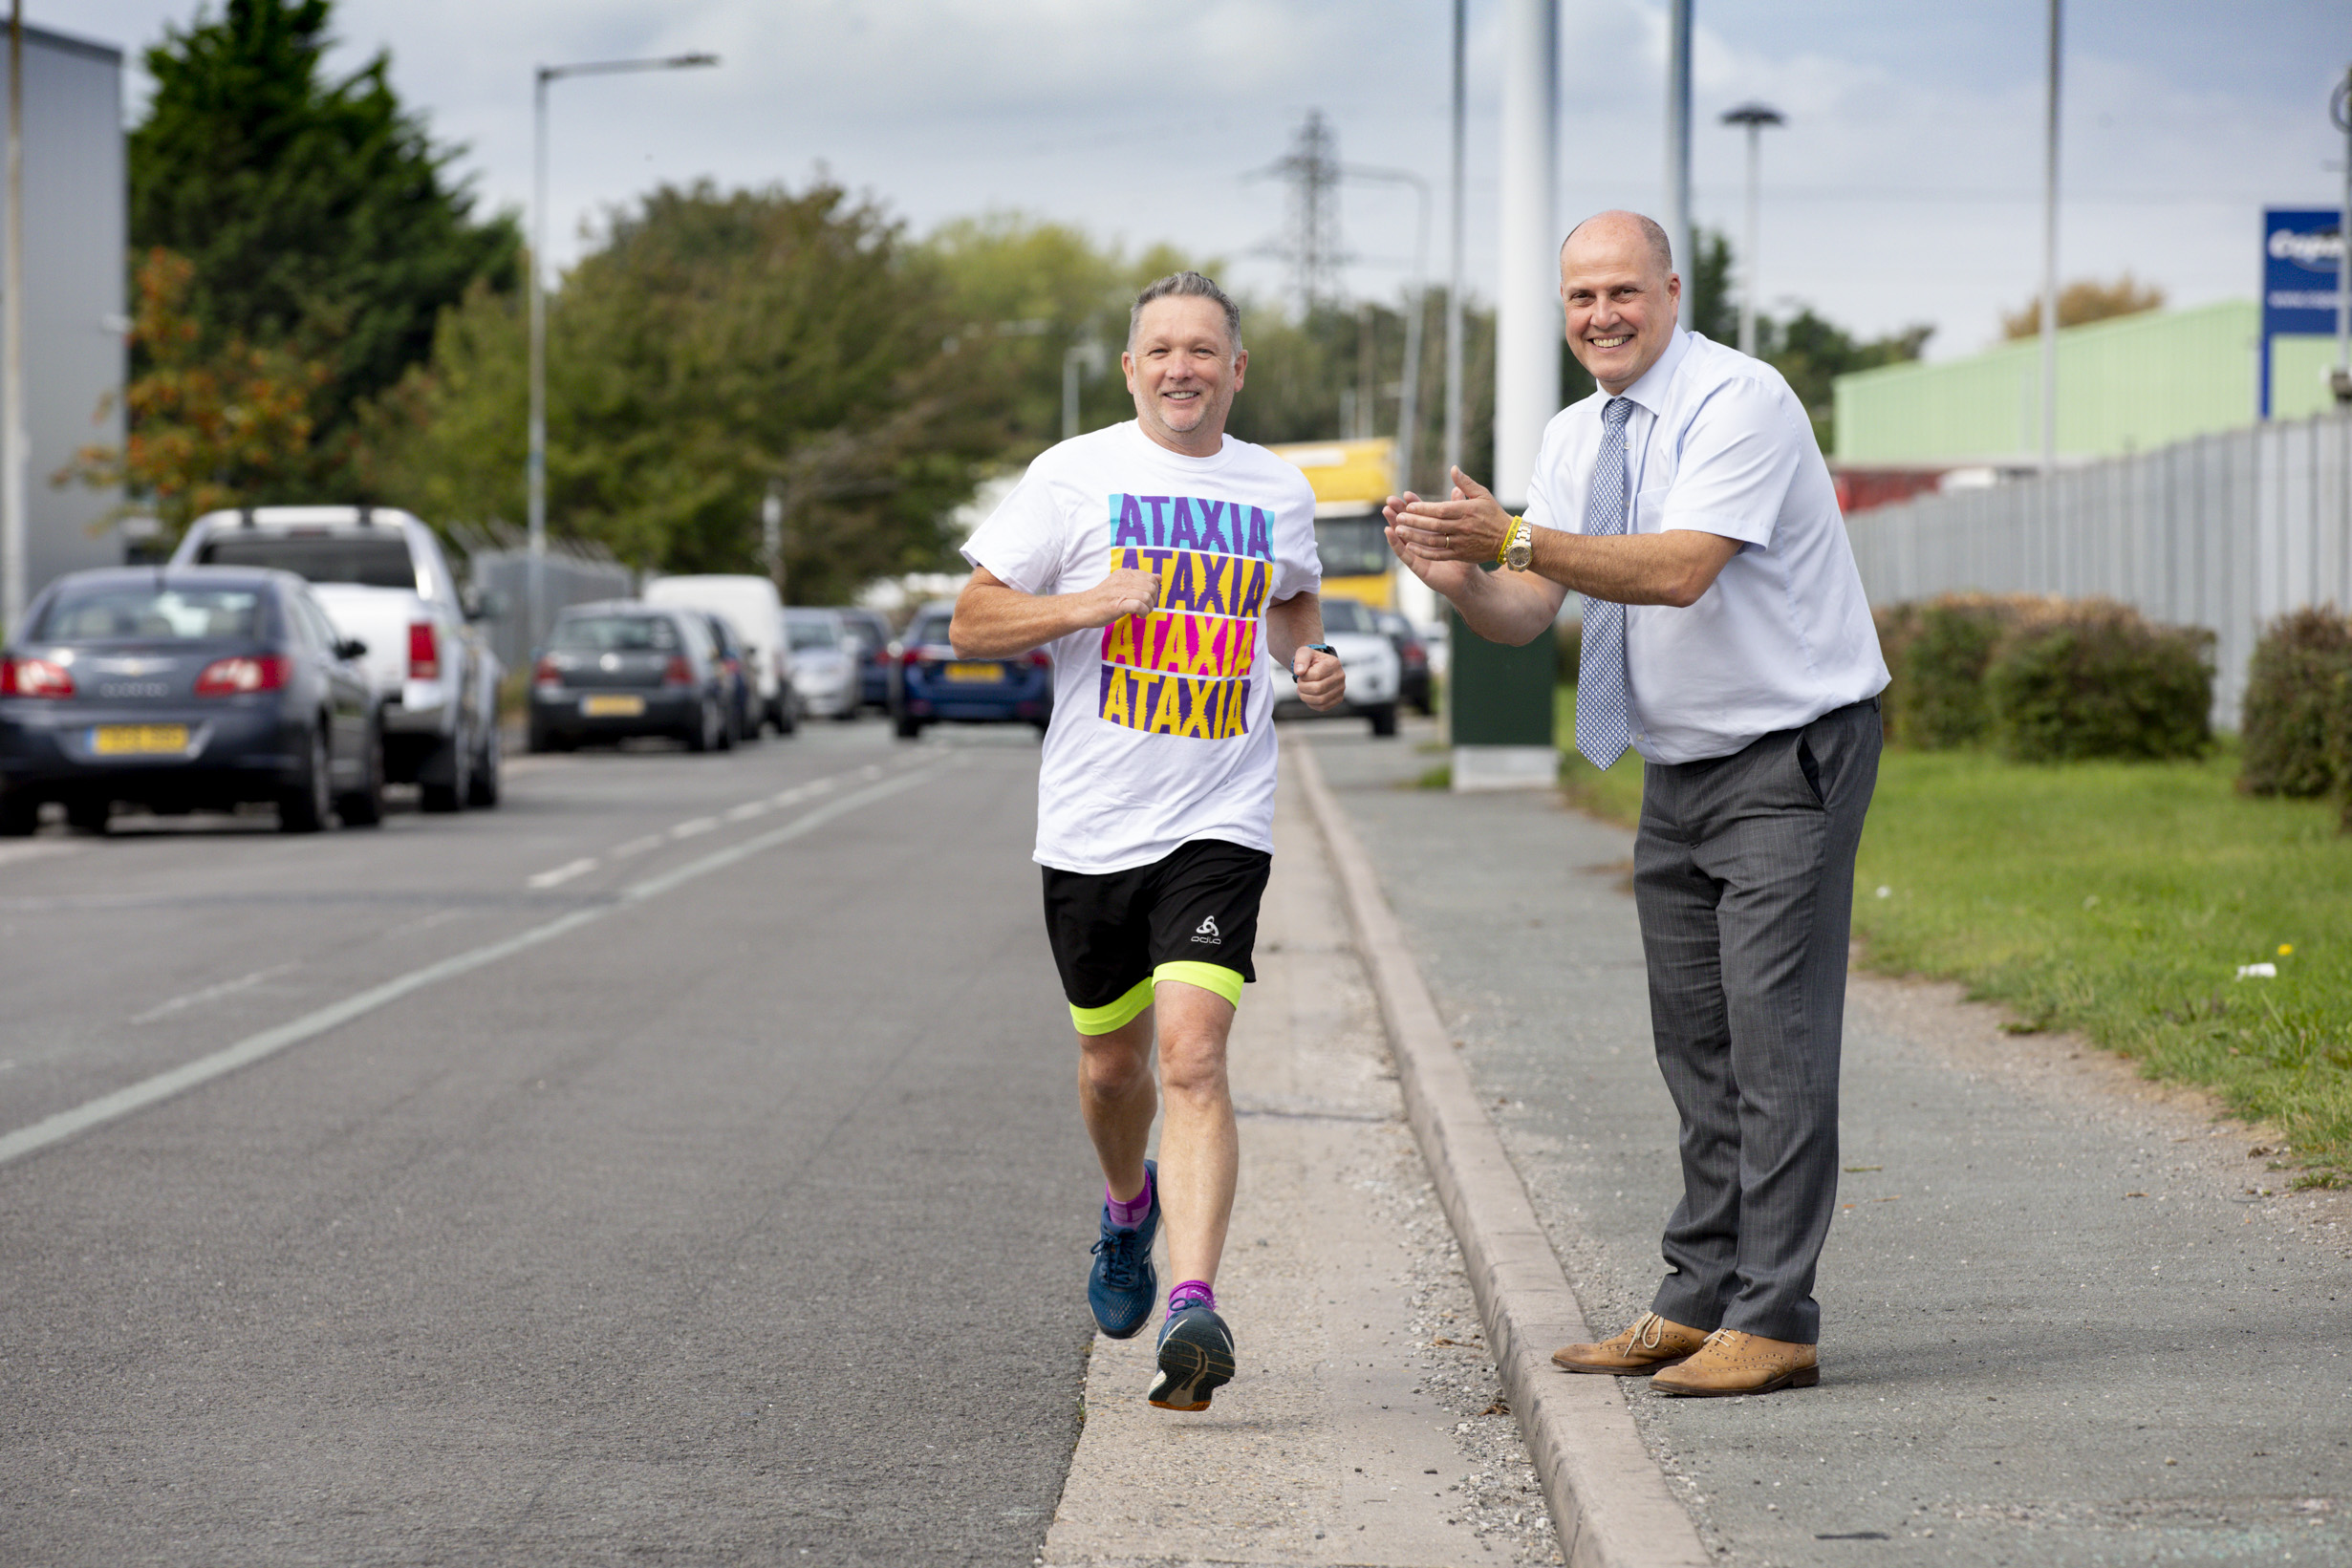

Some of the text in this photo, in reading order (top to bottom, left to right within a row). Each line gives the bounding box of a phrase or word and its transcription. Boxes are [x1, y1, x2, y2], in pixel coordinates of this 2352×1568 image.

[1115, 493, 1273, 562] ATAXIA
[1107, 612, 1254, 677] ATAXIA
[1102, 667, 1244, 740] ATAXIA
[1191, 935, 1221, 945] odlo
